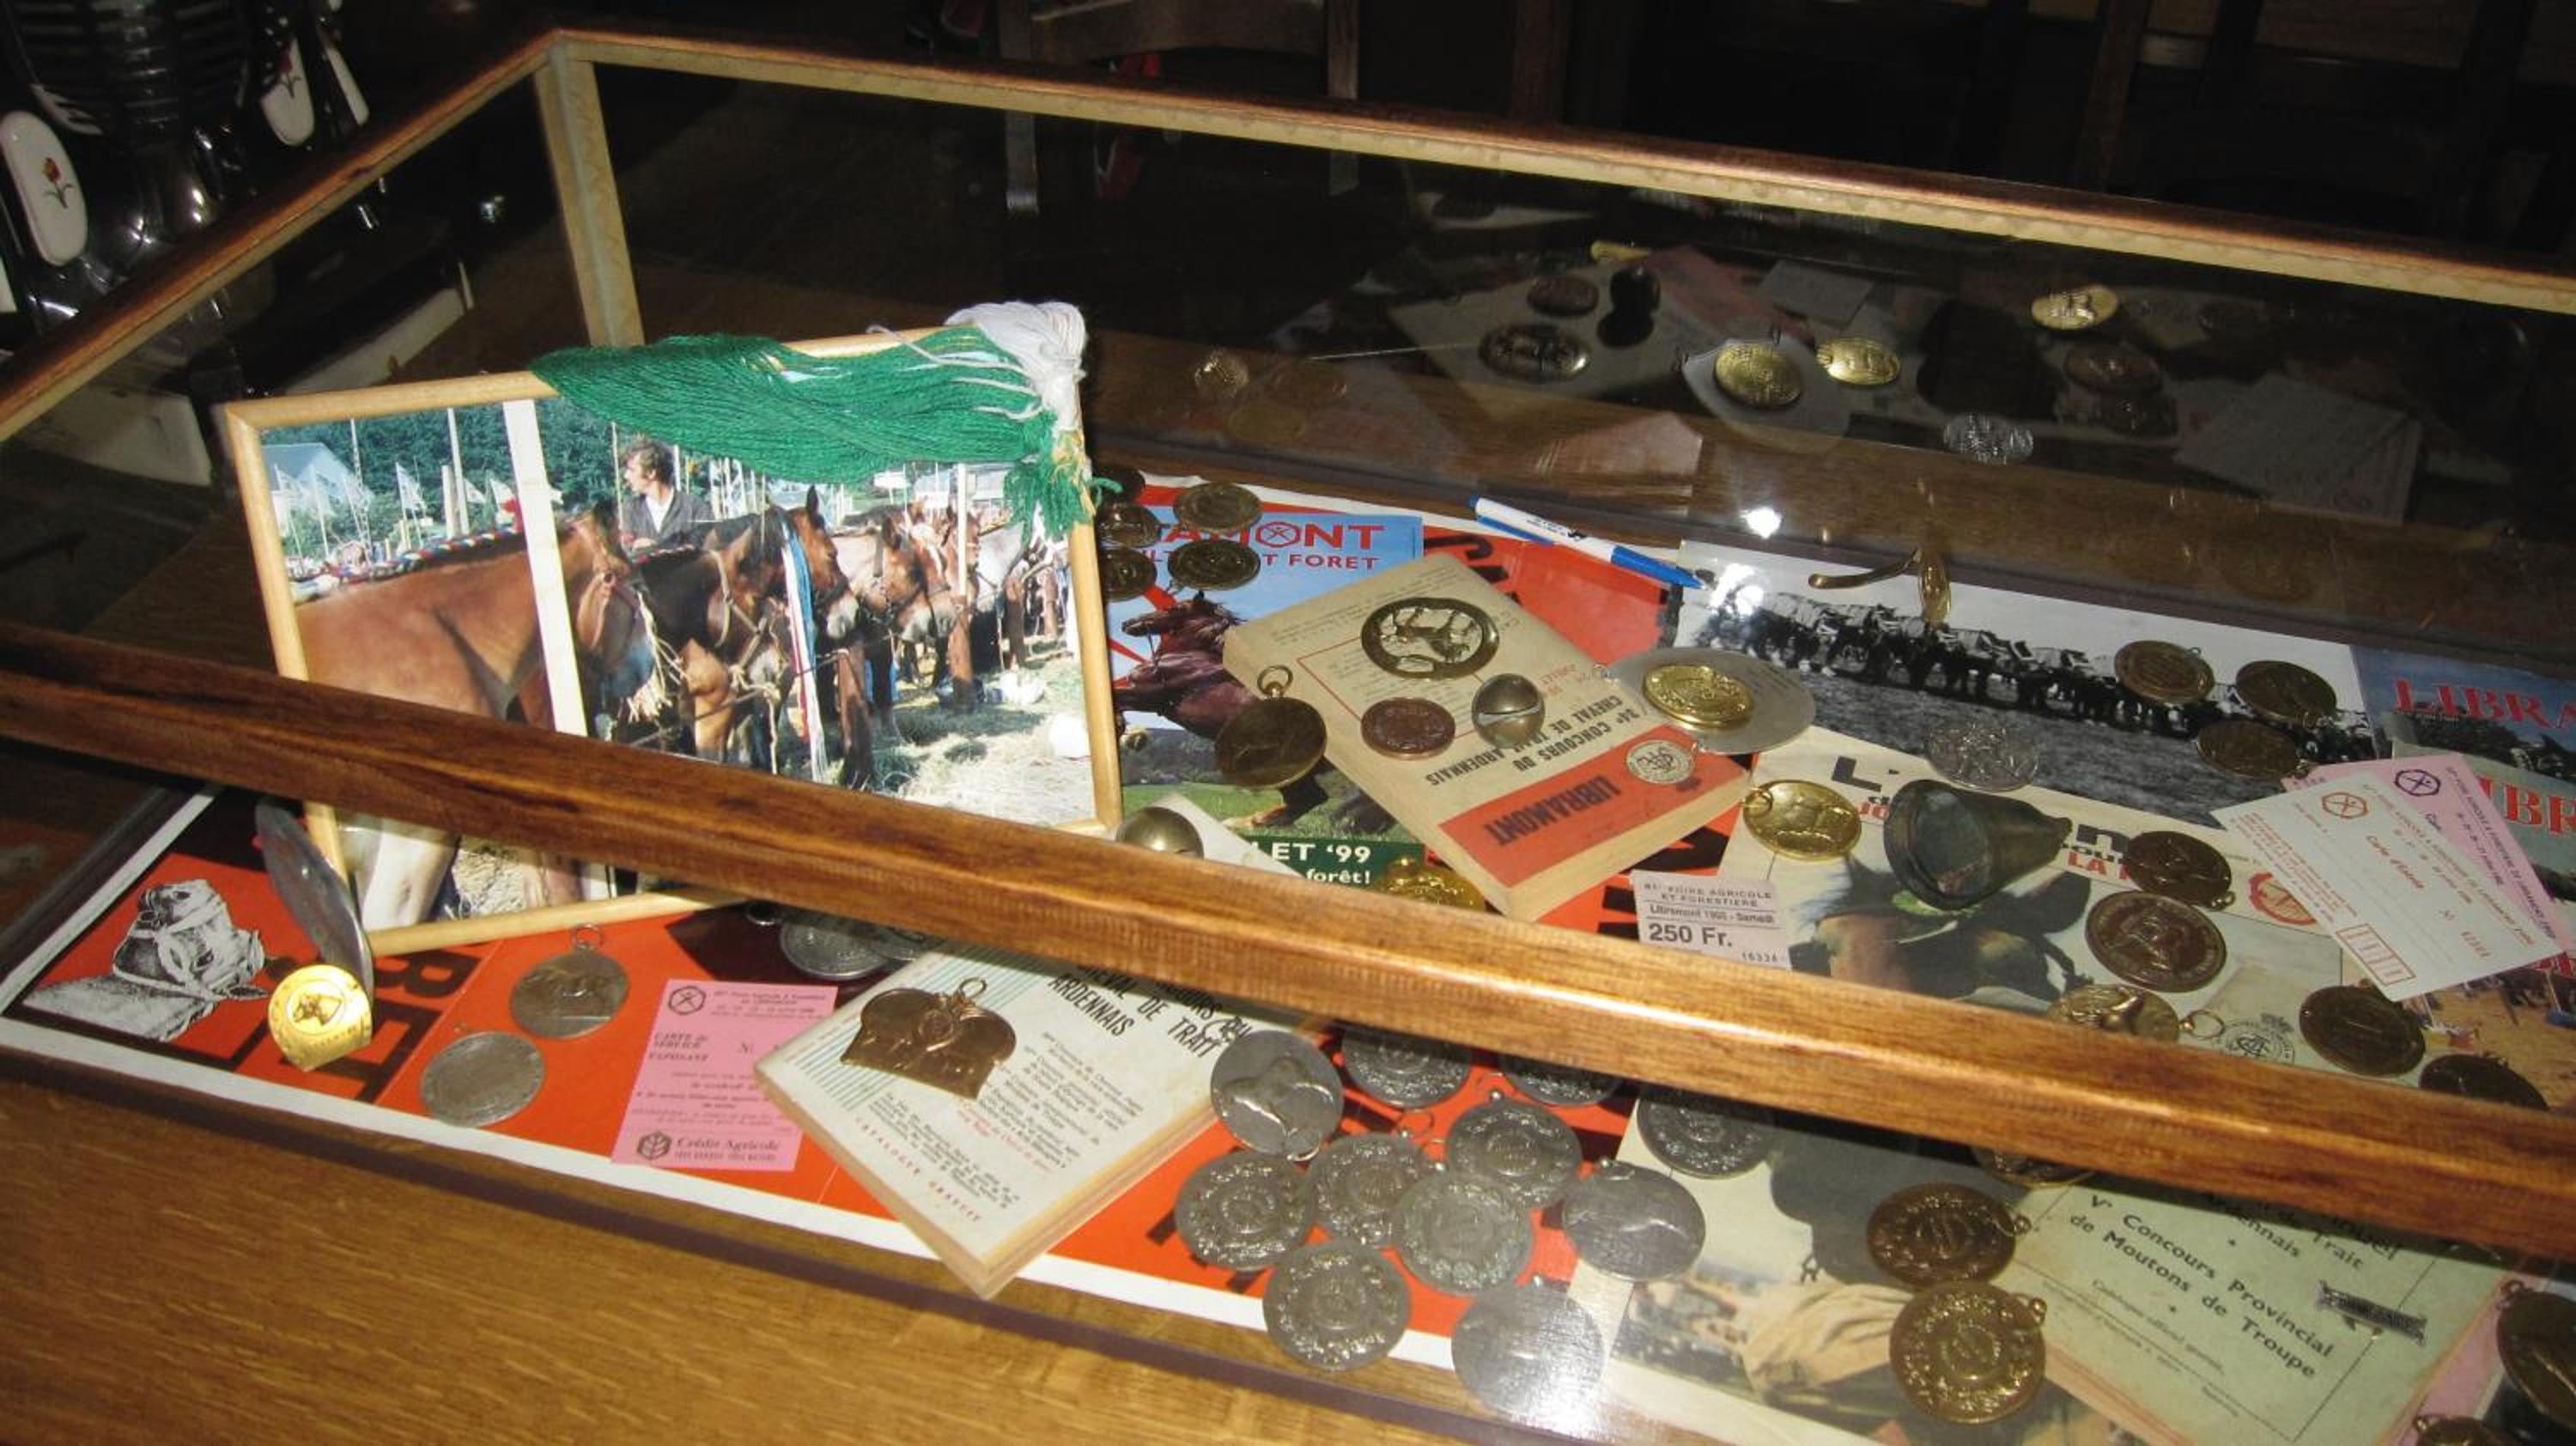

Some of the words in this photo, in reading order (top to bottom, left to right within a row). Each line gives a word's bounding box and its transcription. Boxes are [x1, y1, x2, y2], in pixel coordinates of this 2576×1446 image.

[1287, 553, 1380, 570] FORET
[1572, 694, 1624, 724] CHEVAL
[1537, 722, 1612, 762] CONCOURS
[1552, 721, 1572, 737] DE
[1424, 746, 1508, 787] ARDENNAIS
[1511, 757, 1537, 772] DU
[1483, 775, 1622, 847] LIBRAMONT
[1709, 890, 1772, 900] AGRICOLE
[1648, 922, 1693, 944] 250
[1701, 927, 1733, 947] Fr.
[1047, 972, 1135, 1037] ARDENNAIS
[1137, 995, 1170, 1022] DE
[2069, 1213, 2095, 1234] de
[2102, 1230, 2190, 1293] Moutons
[2201, 1294, 2227, 1316] de
[2241, 1315, 2317, 1378] Troupe
[2122, 1212, 2216, 1279] Concours
[2227, 1278, 2336, 1358] Provincial
